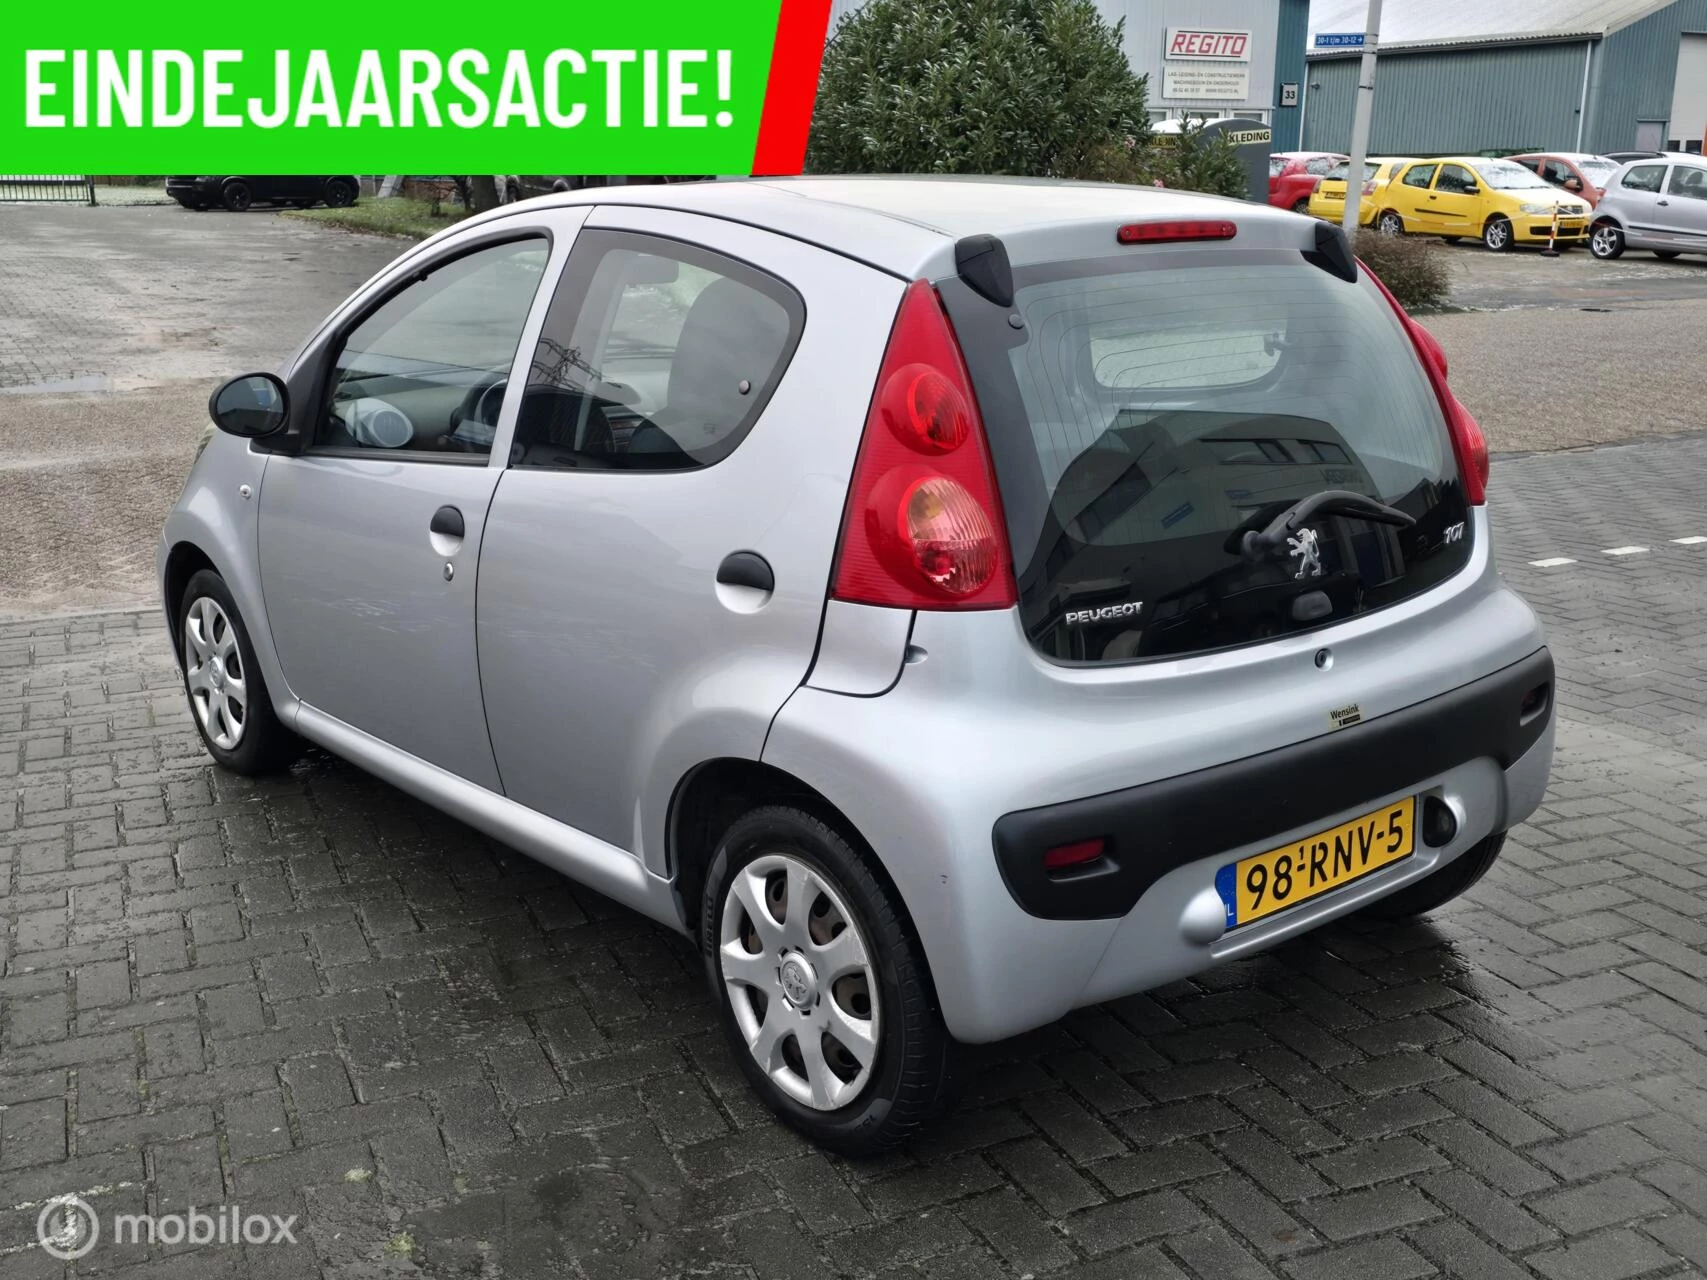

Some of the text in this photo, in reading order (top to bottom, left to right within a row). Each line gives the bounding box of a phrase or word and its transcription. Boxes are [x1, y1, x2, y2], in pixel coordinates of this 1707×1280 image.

[1171, 34, 1247, 54] REGITO
[1285, 90, 1295, 99] 33
[1229, 131, 1270, 143] KLEDING
[1443, 521, 1464, 543] 107
[1065, 601, 1143, 625] PEUGEOT
[1330, 703, 1359, 720] Wensink
